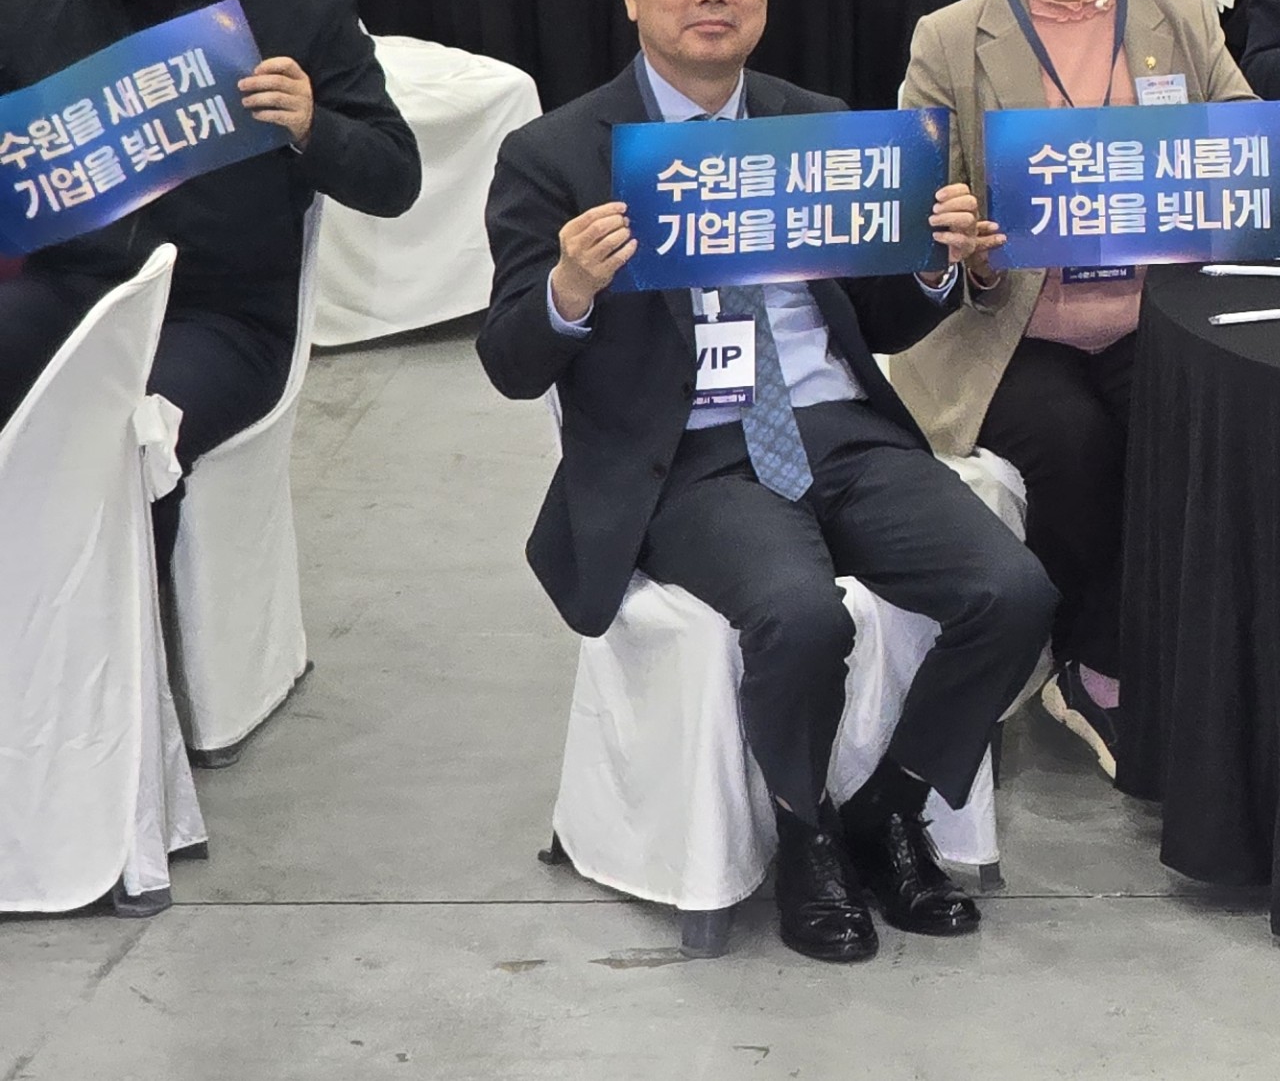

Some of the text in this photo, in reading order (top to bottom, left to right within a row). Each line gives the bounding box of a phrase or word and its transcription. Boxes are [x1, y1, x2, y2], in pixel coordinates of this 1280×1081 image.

[0, 48, 217, 170] 수원을 새롭게
[14, 94, 236, 220] 기업을 빛나게
[657, 148, 901, 203] 수원을 새롭게
[1028, 136, 1270, 186] 수원을 새롭게
[657, 201, 901, 257] 기업을 빛나게
[1030, 187, 1271, 237] 기업을 빛나게
[697, 345, 742, 372] VIP
